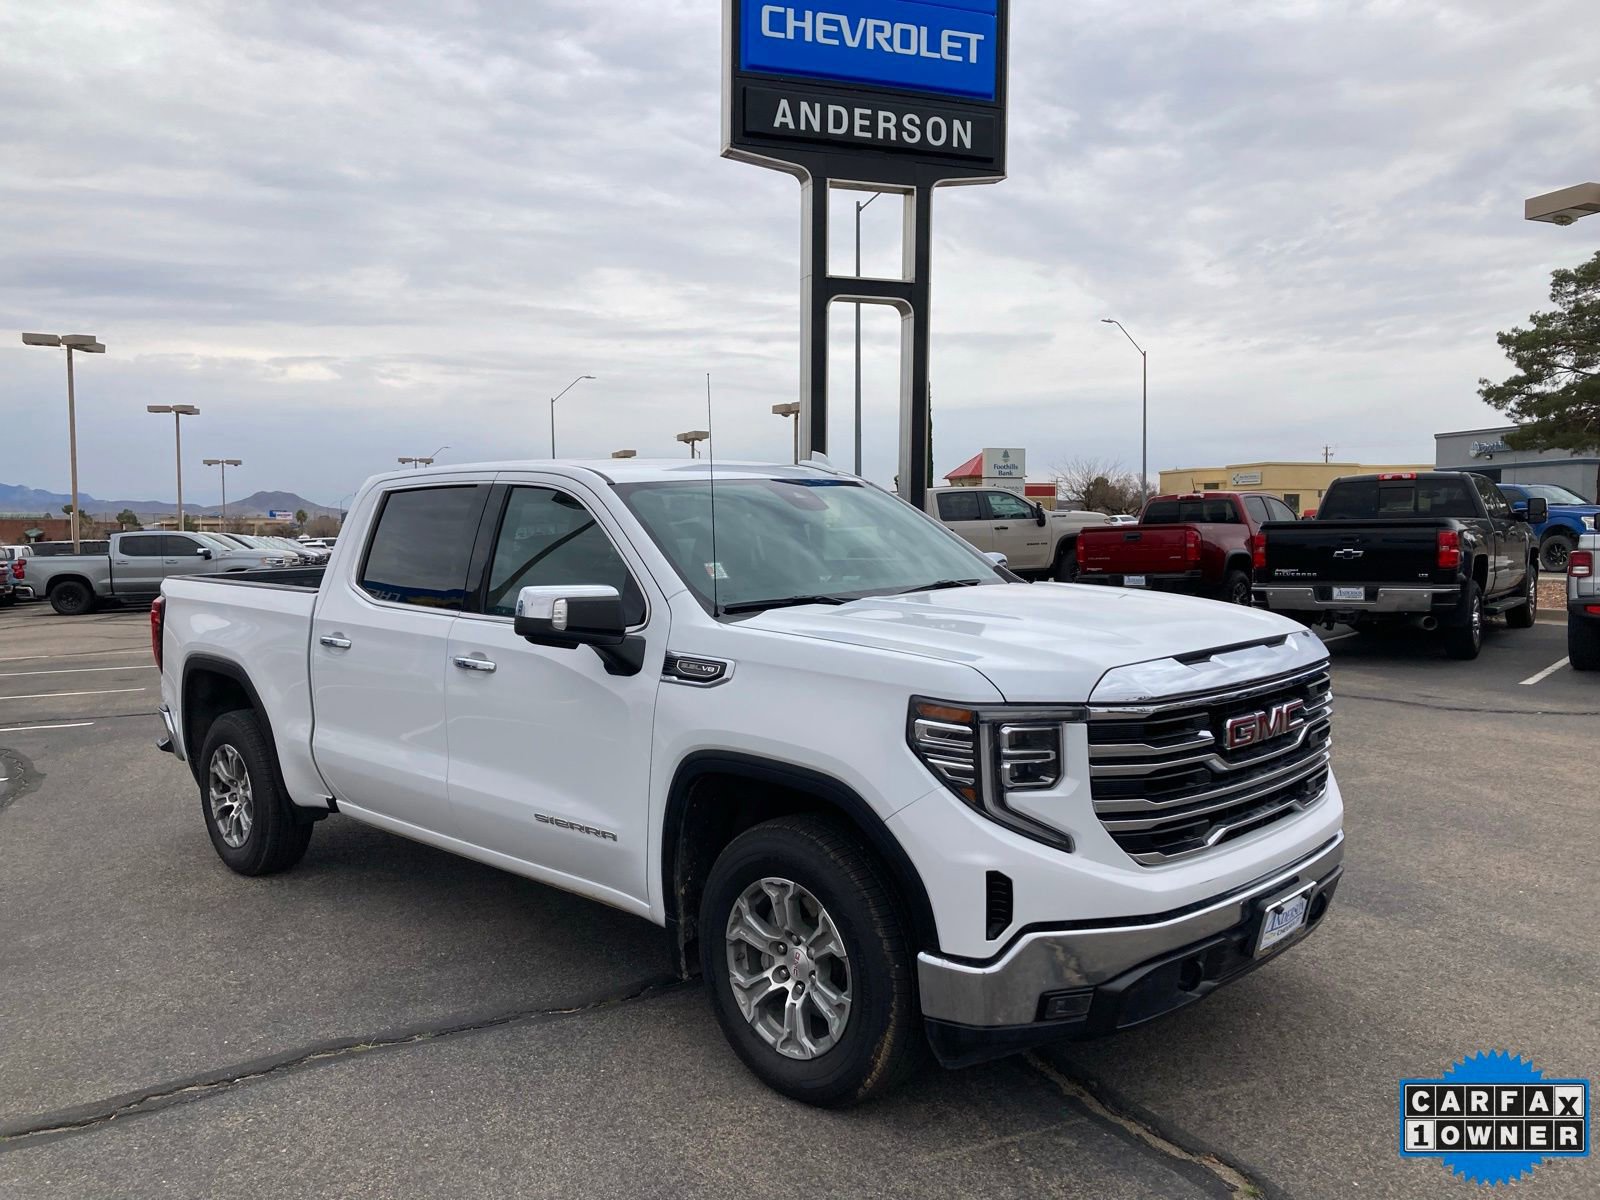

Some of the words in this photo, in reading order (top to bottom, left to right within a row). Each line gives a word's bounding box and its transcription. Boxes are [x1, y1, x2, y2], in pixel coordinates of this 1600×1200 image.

[761, 4, 985, 64] CHEVROLET
[773, 98, 972, 149] ANDERSON
[1225, 699, 1304, 750] GMC
[534, 813, 618, 842] SIERRA
